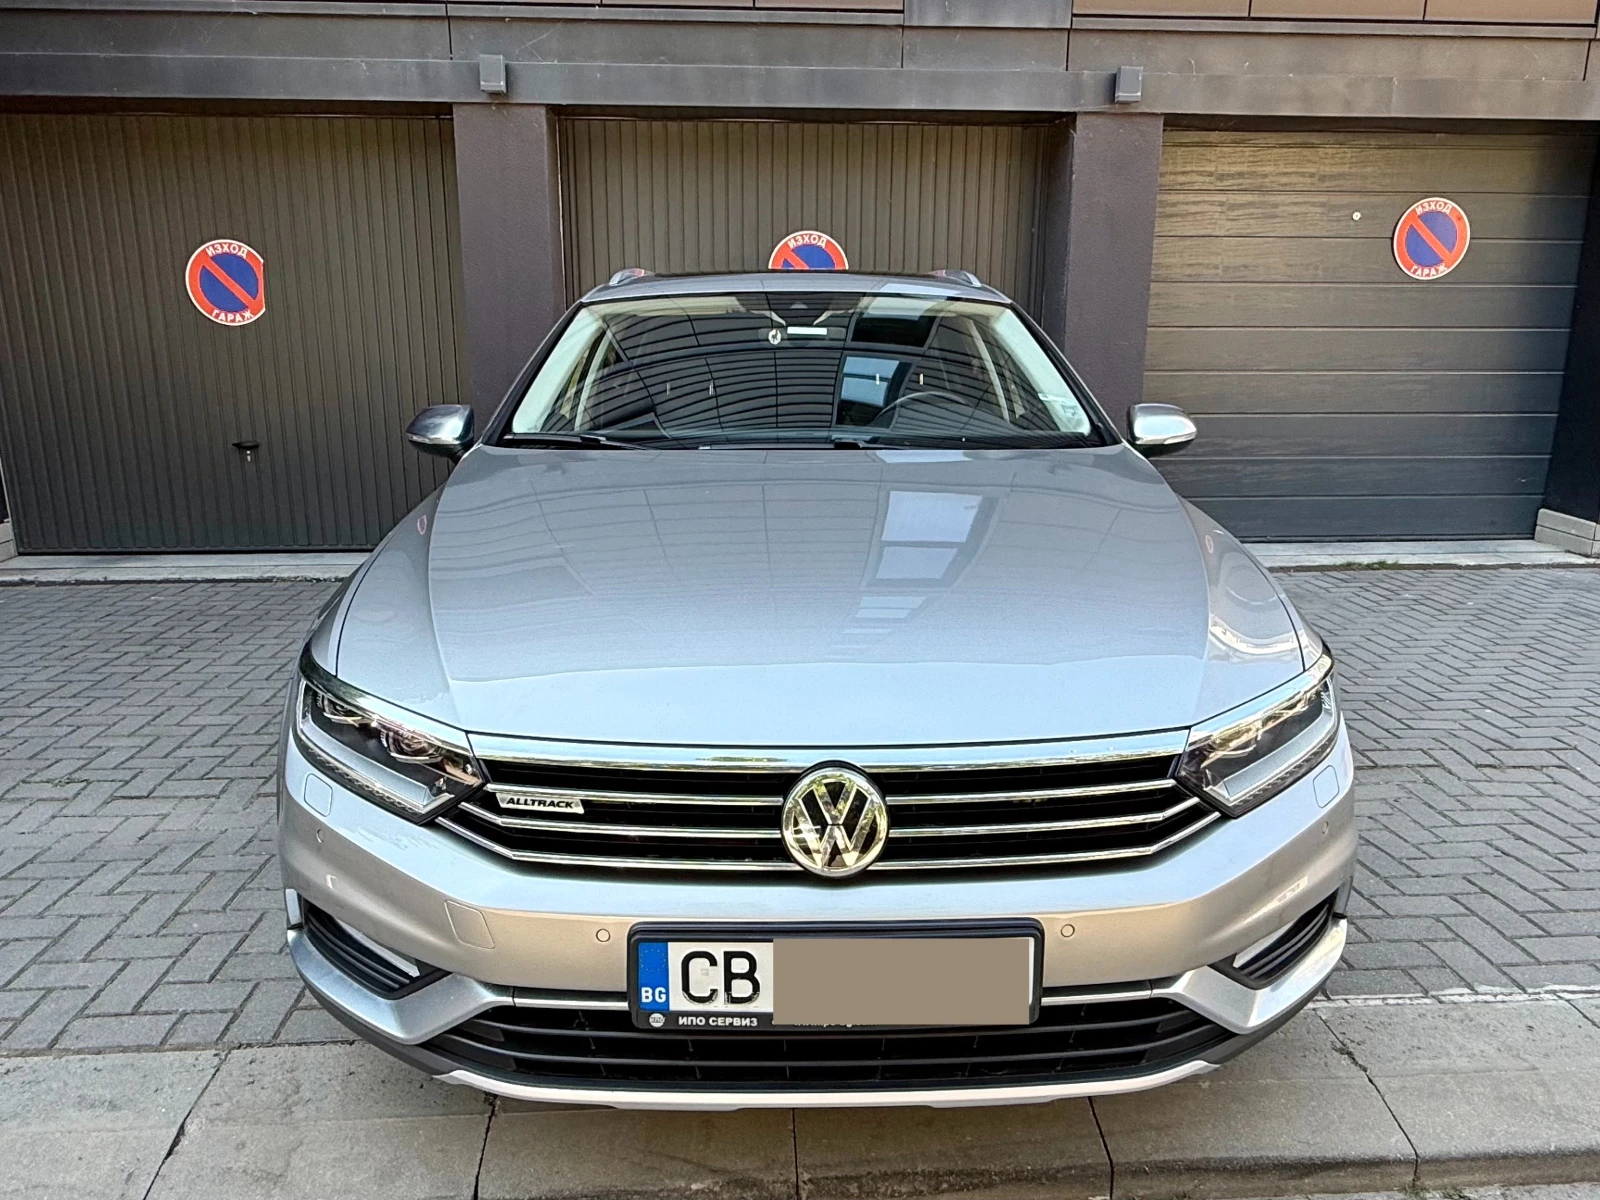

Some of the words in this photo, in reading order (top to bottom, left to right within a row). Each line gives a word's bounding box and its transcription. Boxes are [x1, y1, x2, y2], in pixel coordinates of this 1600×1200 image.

[1415, 201, 1452, 215] ИЗХОД
[787, 234, 827, 249] ИЗХОД
[205, 243, 248, 259] ИЗХОД
[1410, 263, 1448, 277] ГАРАЖ
[212, 309, 254, 322] ГАРАЖ
[506, 797, 574, 809] ALLTRACK
[641, 986, 667, 1003] BG
[678, 1016, 706, 1026] ИПО
[708, 1016, 758, 1027] СЕРВИЗ
